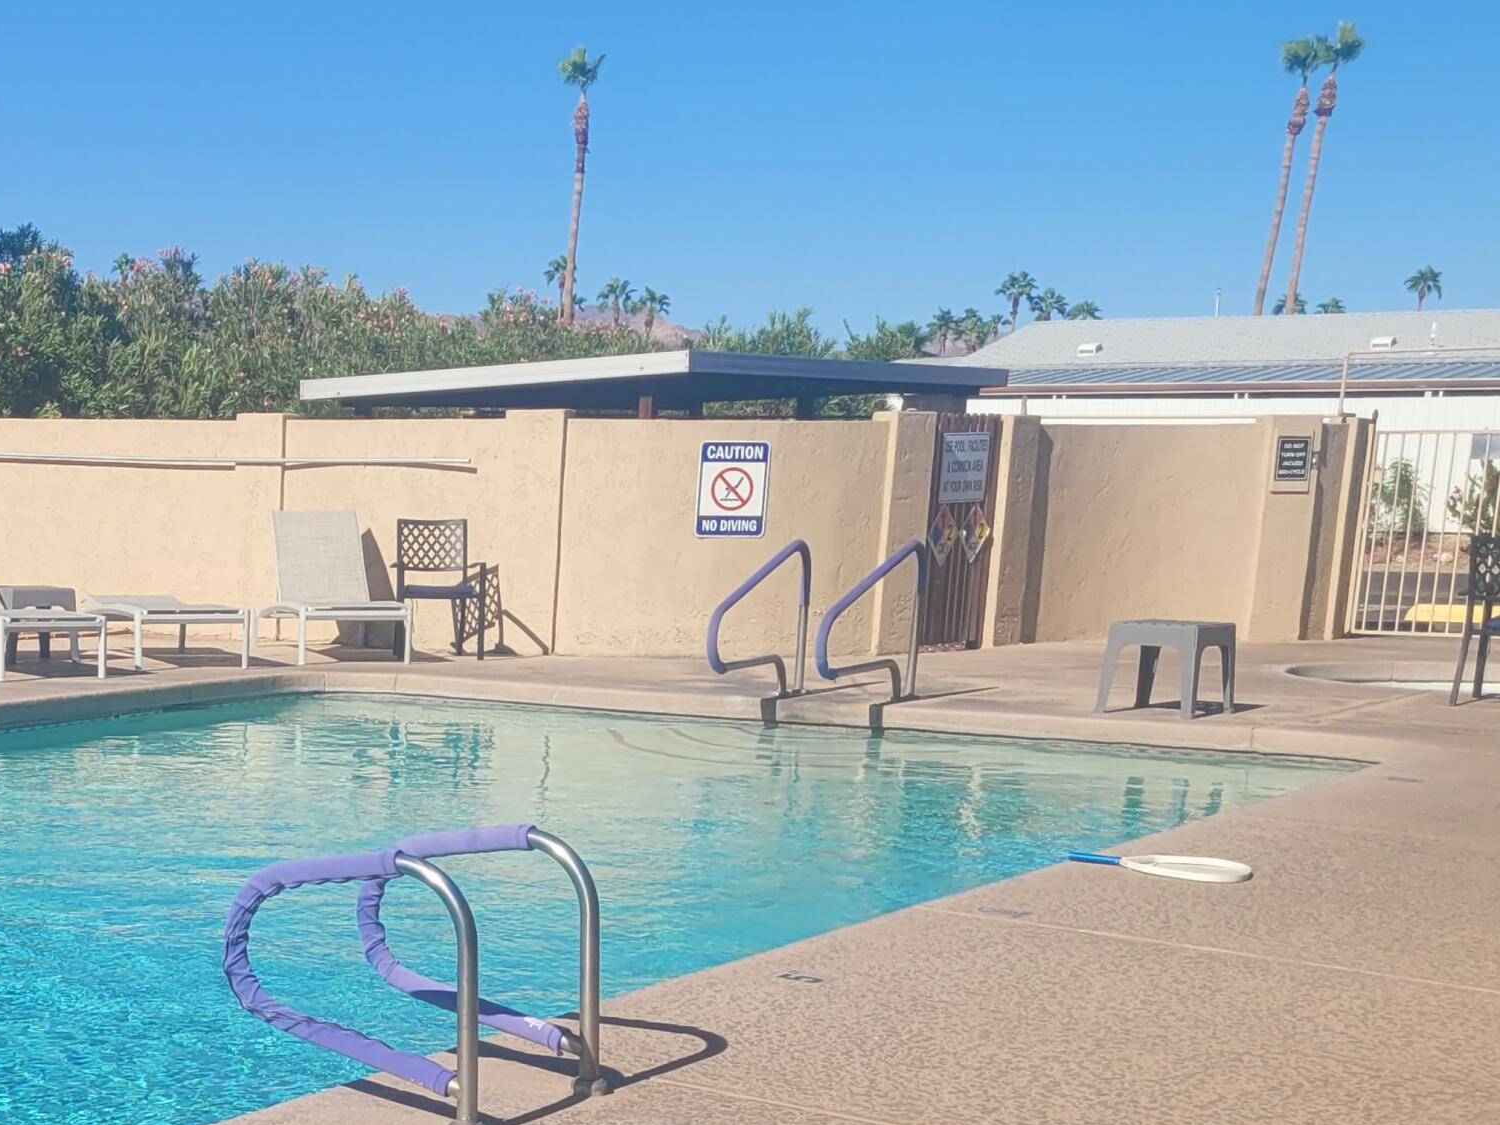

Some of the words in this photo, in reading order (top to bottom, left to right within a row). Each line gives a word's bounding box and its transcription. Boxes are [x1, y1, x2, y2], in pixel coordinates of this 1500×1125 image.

[707, 445, 764, 460] CAUTION
[701, 519, 717, 532] NO
[719, 519, 757, 532] DIVING
[946, 523, 953, 541] 2
[977, 522, 984, 539] 2
[776, 973, 824, 983] 5
